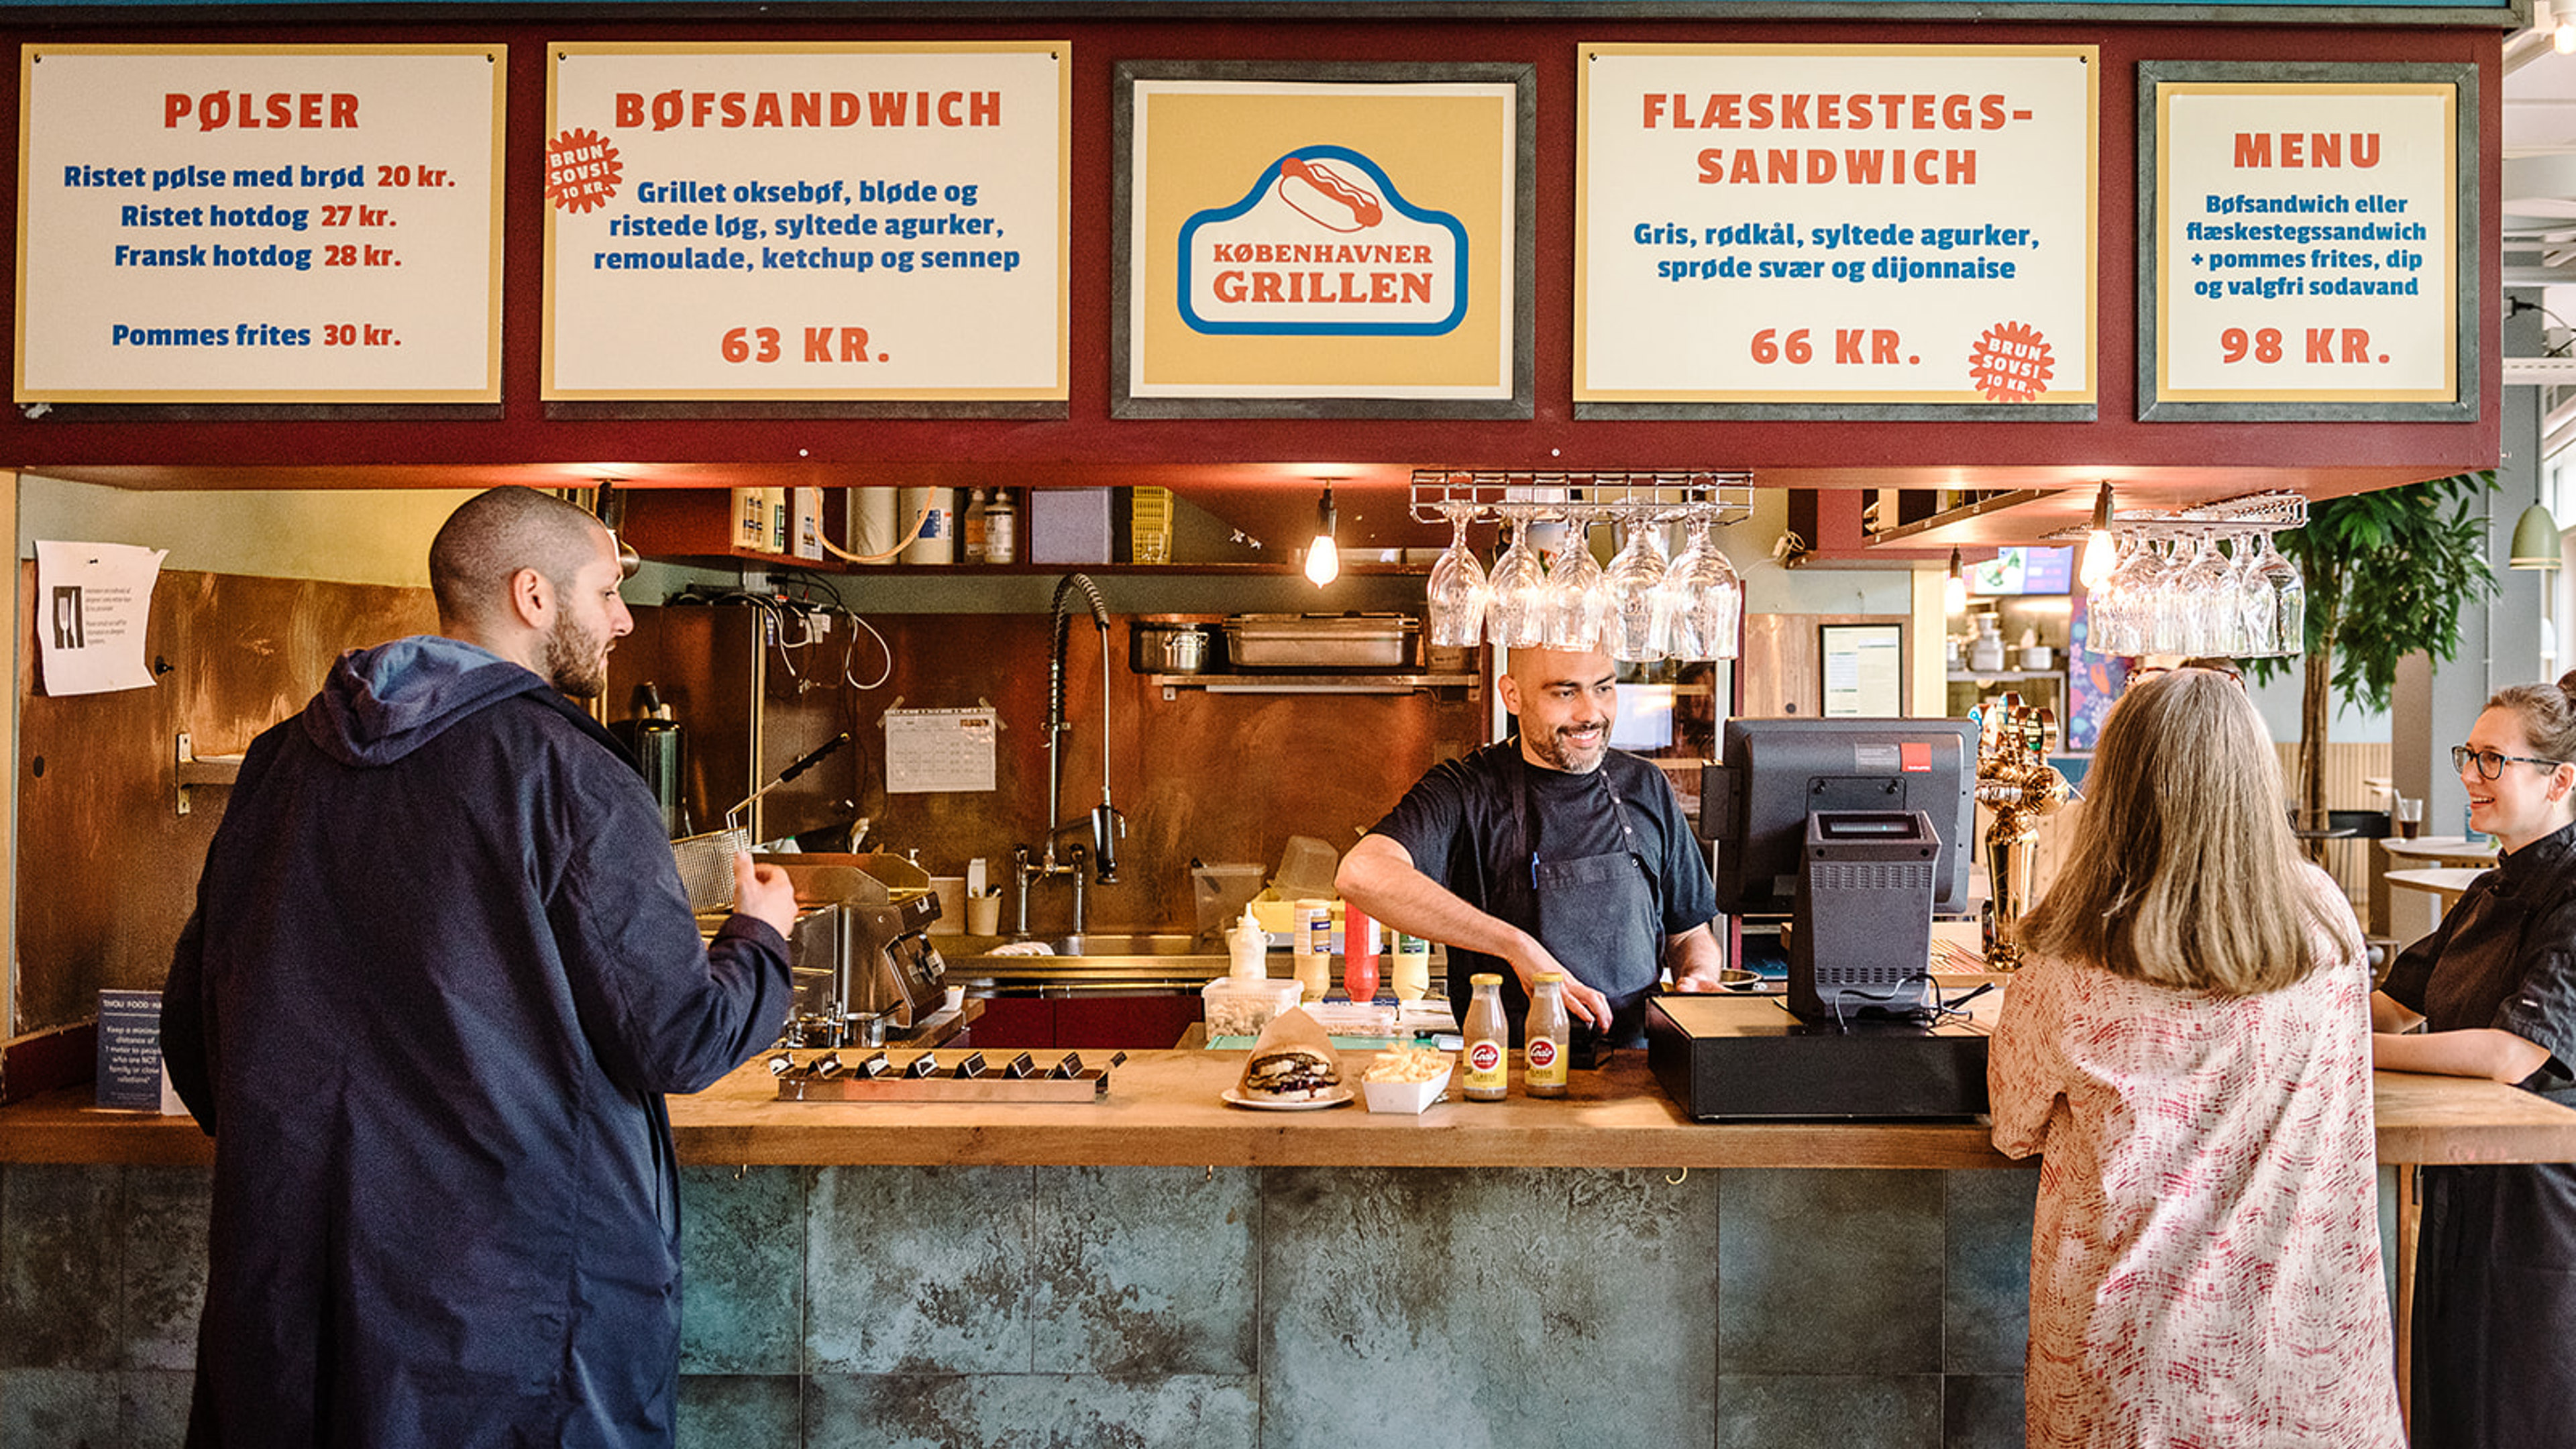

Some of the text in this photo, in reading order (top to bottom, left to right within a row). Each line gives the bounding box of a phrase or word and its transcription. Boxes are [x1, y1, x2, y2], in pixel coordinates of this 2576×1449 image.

[164, 90, 358, 132] PØLSER
[616, 89, 1000, 131] BØFSANDWICH
[1644, 93, 2032, 130] FLÆSKESTEGS-
[550, 144, 604, 168] BRUN
[2234, 133, 2379, 168] MENU
[64, 164, 455, 191] Ristet pølse med brød 20 kr.
[551, 161, 609, 185] SOVS!
[1697, 148, 1976, 185] SANDWICH
[562, 181, 609, 199] 10 KR.
[637, 180, 978, 207] Grillet oksebøf, bløde og
[121, 205, 396, 231] Ristet hotdog 27 kr.
[2206, 194, 2408, 215] Bøfsandwich eller
[610, 213, 1004, 241] ristede løg, syltede agurker,
[1633, 222, 2039, 250] Gris, rødkål, syltede agurker,
[2186, 221, 2427, 245] flæskestegssandwich
[115, 244, 402, 271] Fransk hotdog 28 kr.
[594, 246, 1020, 273] remoulade, ketchup og sennep
[1214, 244, 1433, 264] KØBENHAVNER
[2190, 248, 2422, 272] + pommes frites, dip
[1658, 255, 2017, 284] sprøde svær og dijonnaise
[1213, 270, 1433, 303] GRILLEN
[2194, 276, 2419, 300] og valgfri sodavand
[113, 323, 401, 346] Pommes frites 30 kr.
[721, 327, 890, 363] 63 KR.
[1751, 328, 1920, 365] 66 KR.
[2221, 328, 2390, 364] 98 KR.
[1988, 337, 2042, 361] BRUN
[1986, 374, 2031, 394] 10 KR.
